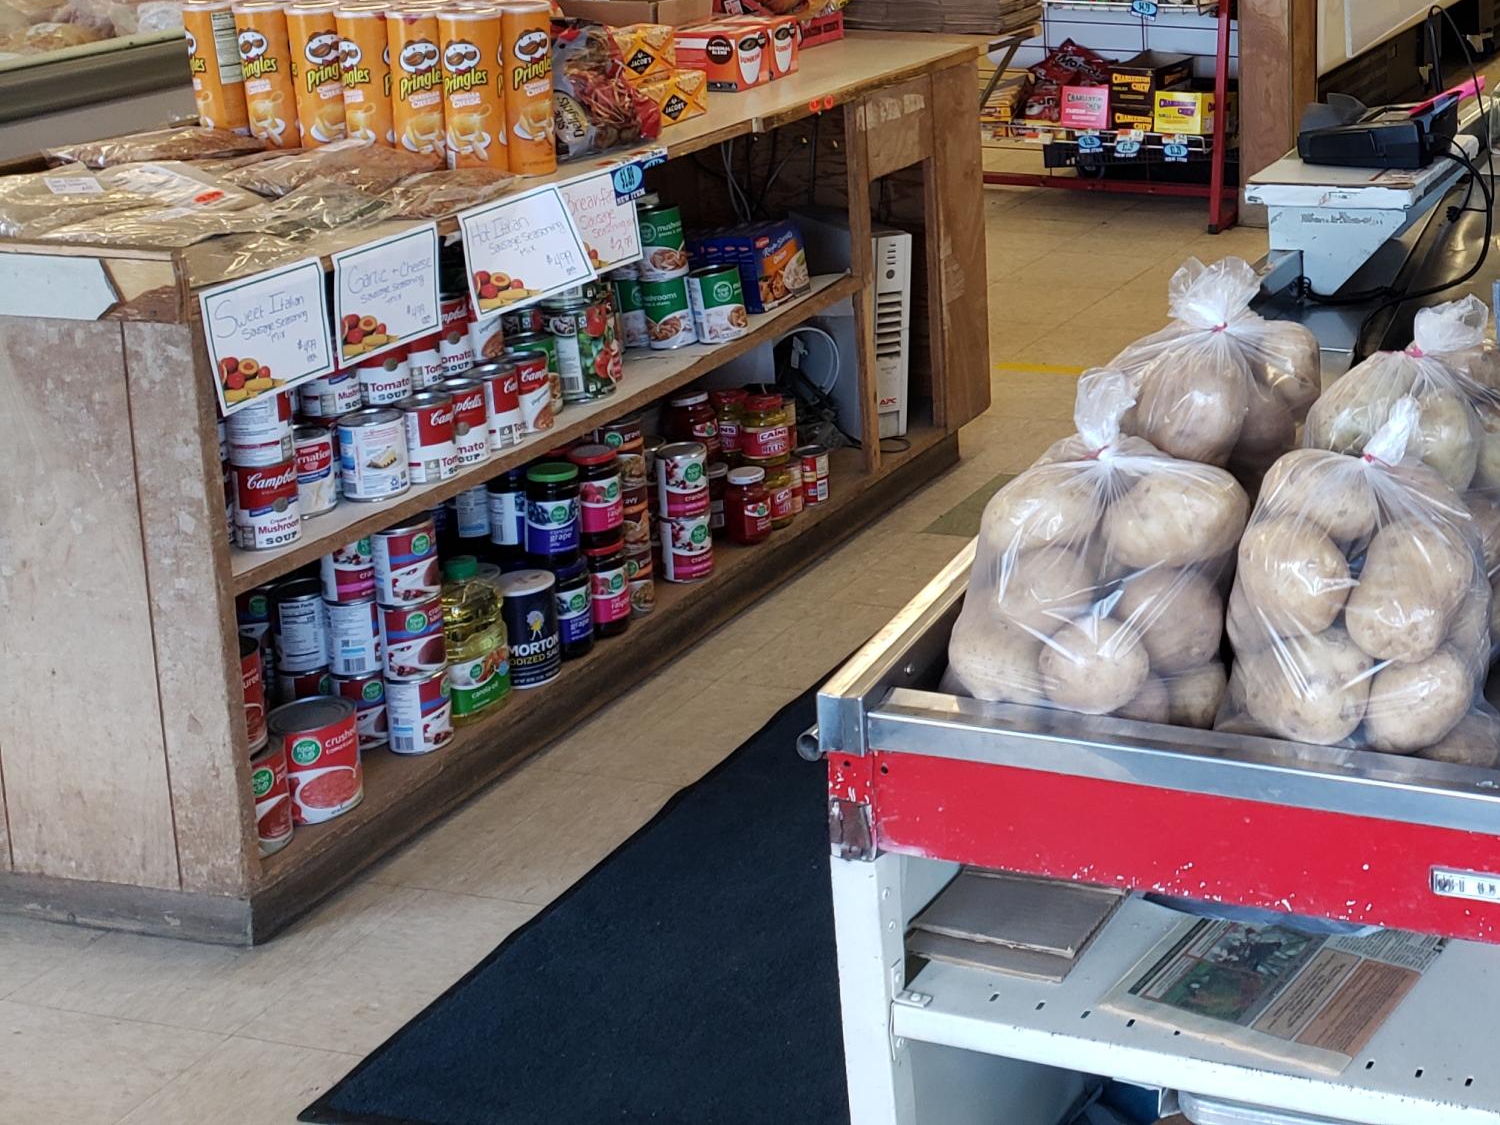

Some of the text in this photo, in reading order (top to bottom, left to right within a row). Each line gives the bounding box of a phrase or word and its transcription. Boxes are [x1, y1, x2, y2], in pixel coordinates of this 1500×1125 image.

[307, 61, 340, 93] Pring
[343, 69, 370, 88] ngles
[444, 68, 488, 95] Pringles
[1131, 82, 1151, 93] CHEW
[617, 188, 646, 205] NEW ITEM
[468, 221, 491, 246] Hot
[214, 291, 304, 339] Sweet Italian
[441, 350, 473, 365] omato
[444, 361, 470, 373] SOUP
[369, 376, 410, 393] Tomato
[376, 388, 408, 401] SOUP
[880, 397, 897, 406] APC
[297, 448, 331, 466] rnation
[456, 442, 485, 456] mato
[265, 530, 298, 545] SOUP
[509, 633, 559, 656] MORTON
[510, 654, 546, 666] ODIZED
[296, 743, 315, 755] food
